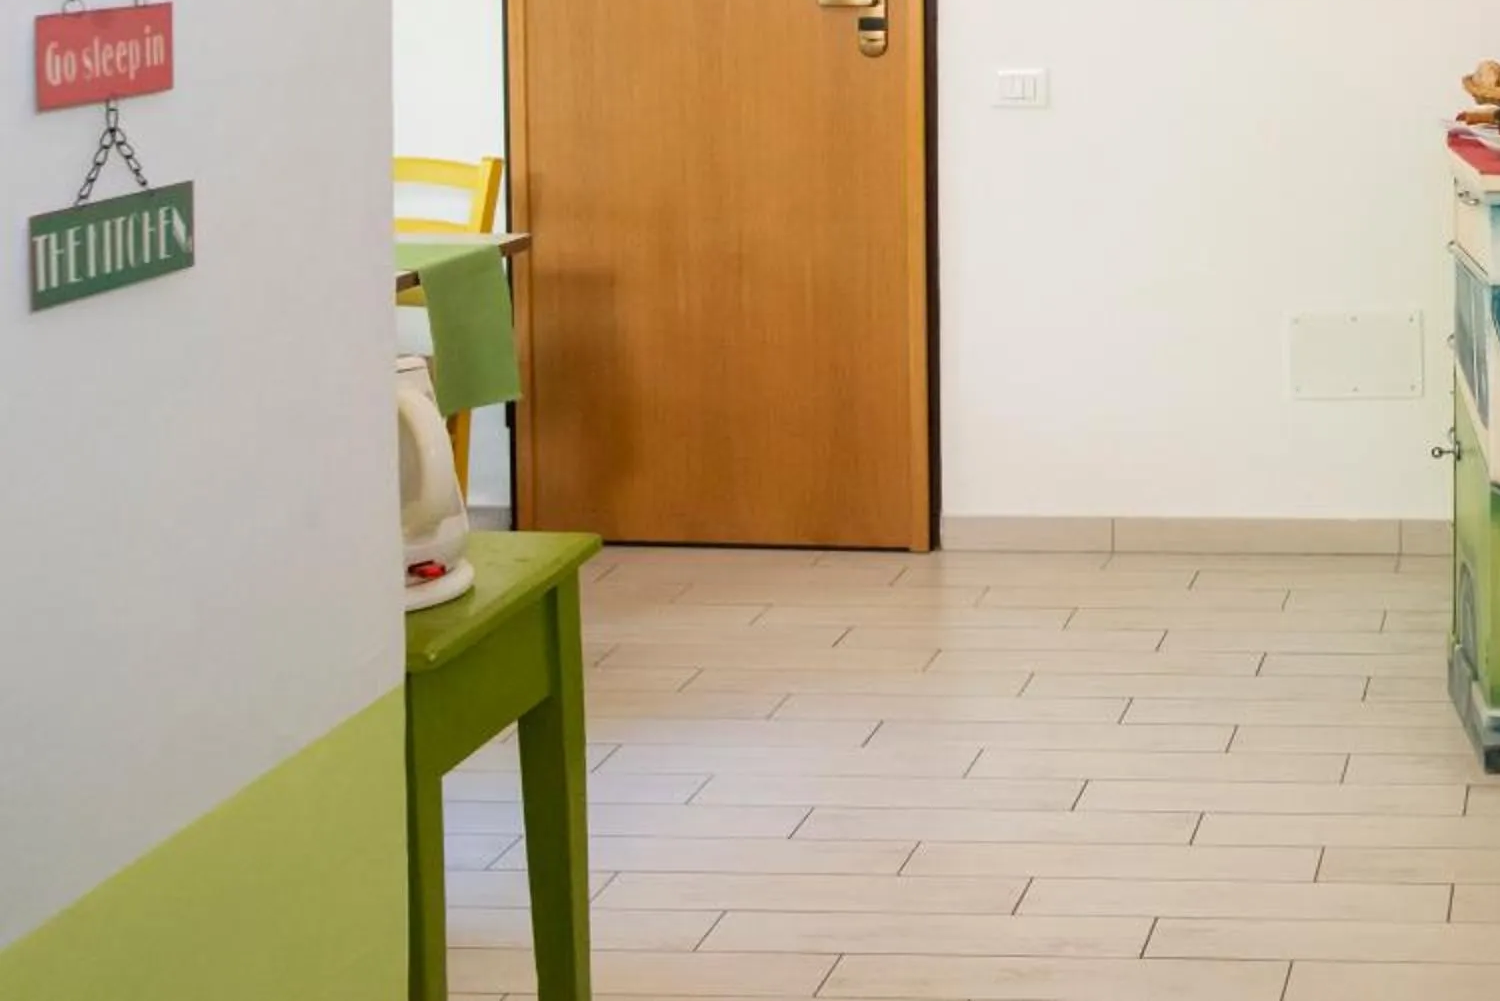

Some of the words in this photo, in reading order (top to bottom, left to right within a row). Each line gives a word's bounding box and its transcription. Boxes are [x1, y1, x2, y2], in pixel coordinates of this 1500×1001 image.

[45, 40, 77, 87] Go
[82, 36, 141, 81] sleep
[143, 24, 165, 67] in
[32, 225, 83, 292] THE
